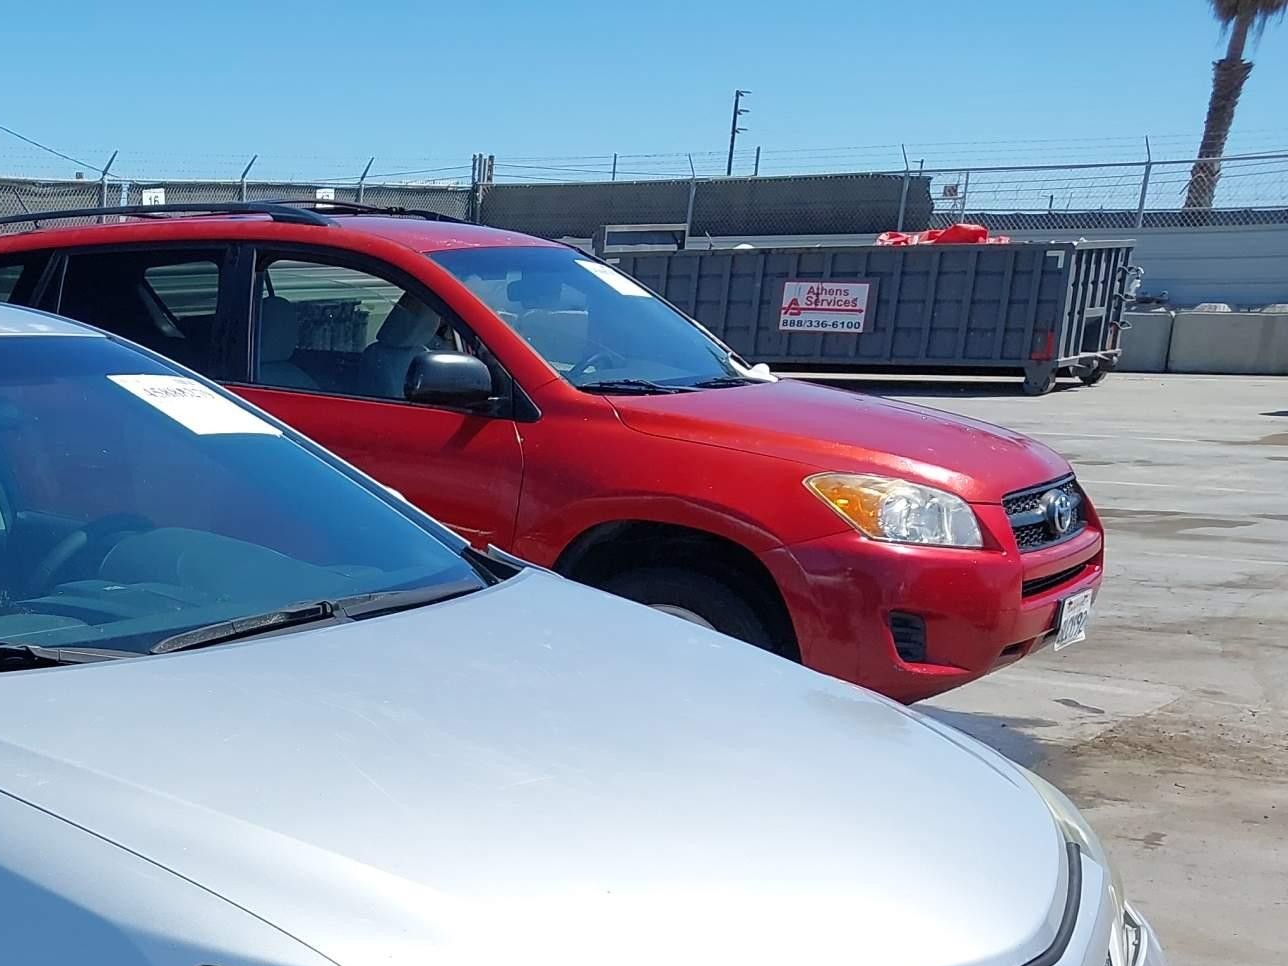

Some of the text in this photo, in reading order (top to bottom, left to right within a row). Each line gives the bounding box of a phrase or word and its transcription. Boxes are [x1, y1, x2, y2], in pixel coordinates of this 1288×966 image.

[807, 285, 849, 296] Athens
[805, 296, 858, 307] Services
[782, 319, 861, 329] 888/336-6100
